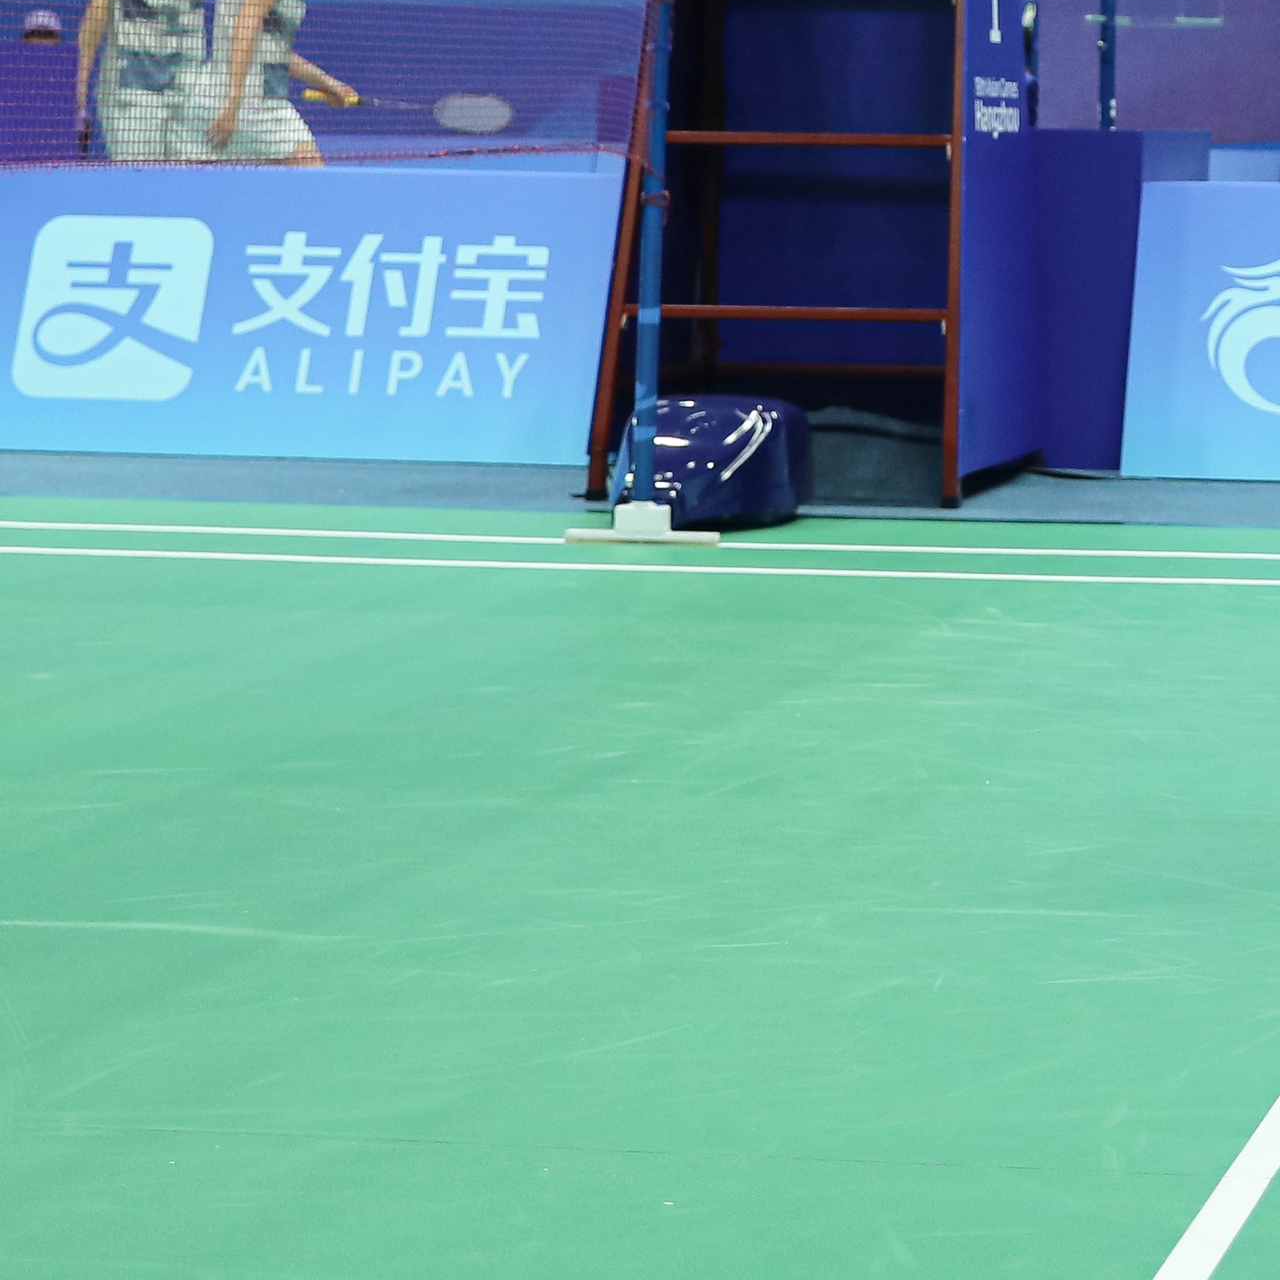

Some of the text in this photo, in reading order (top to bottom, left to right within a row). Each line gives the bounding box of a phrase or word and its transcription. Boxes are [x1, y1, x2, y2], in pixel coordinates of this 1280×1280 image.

[232, 231, 550, 339] 支付宝
[233, 347, 530, 398] ALIPAY
